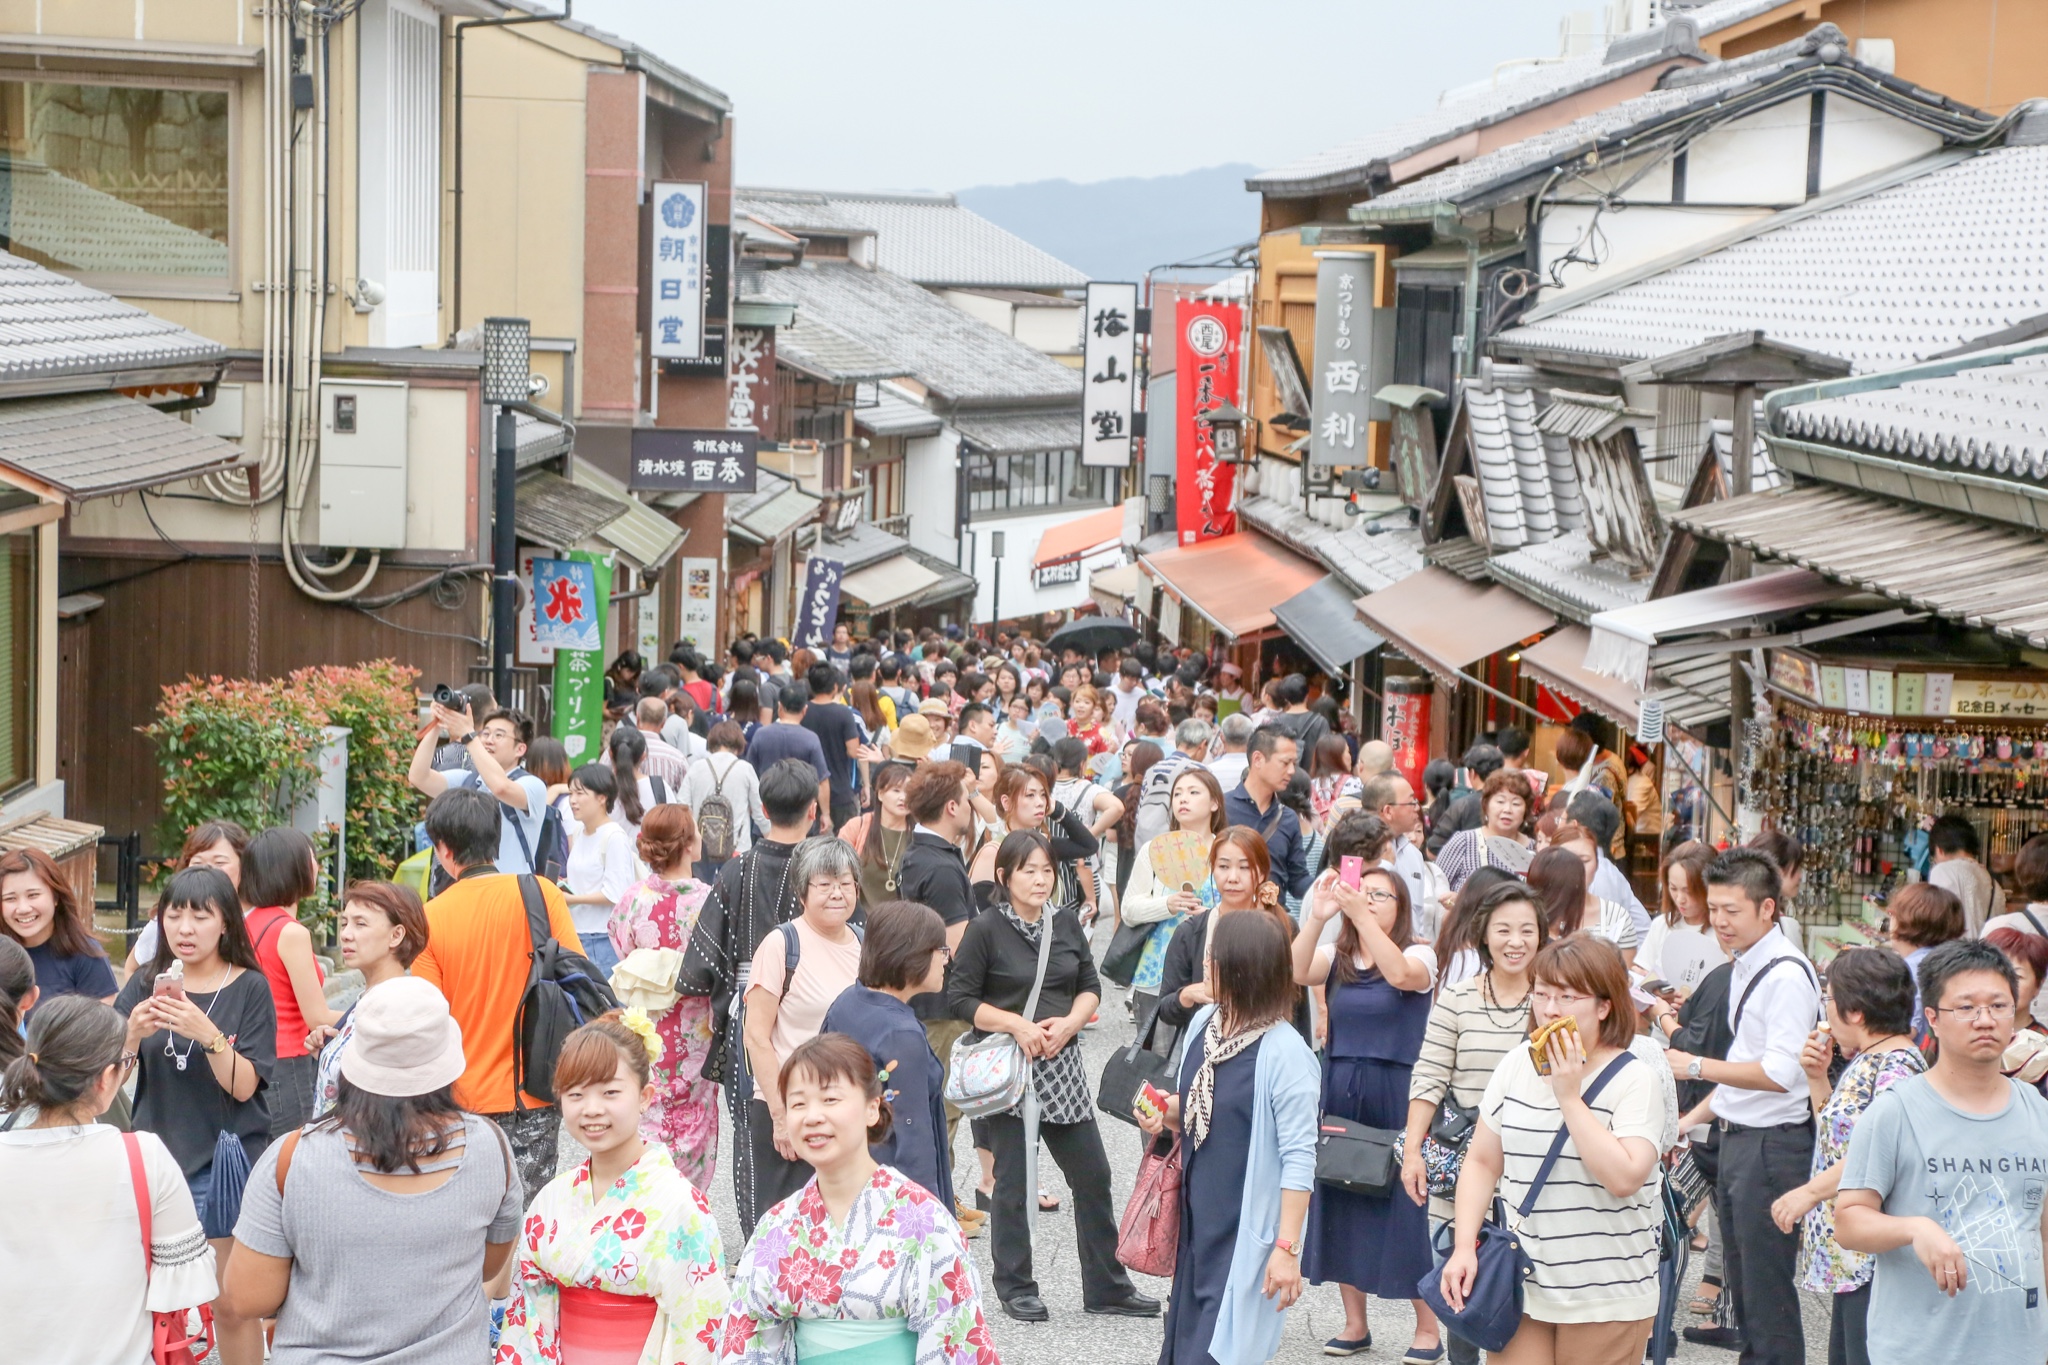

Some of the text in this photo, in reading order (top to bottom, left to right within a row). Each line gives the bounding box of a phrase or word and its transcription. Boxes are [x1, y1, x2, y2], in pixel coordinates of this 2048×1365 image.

[658, 235, 685, 344] 朝日堂
[1335, 273, 1355, 350] 京つけもの
[1200, 322, 1214, 350] 西尾
[1092, 308, 1130, 442] 梅山堂
[1321, 360, 1360, 449] 西利
[638, 456, 746, 484] 清水焼 西秀
[693, 439, 744, 454] 有限会社
[544, 576, 585, 625] 氷
[1927, 1156, 2047, 1175] SHANGHAI
